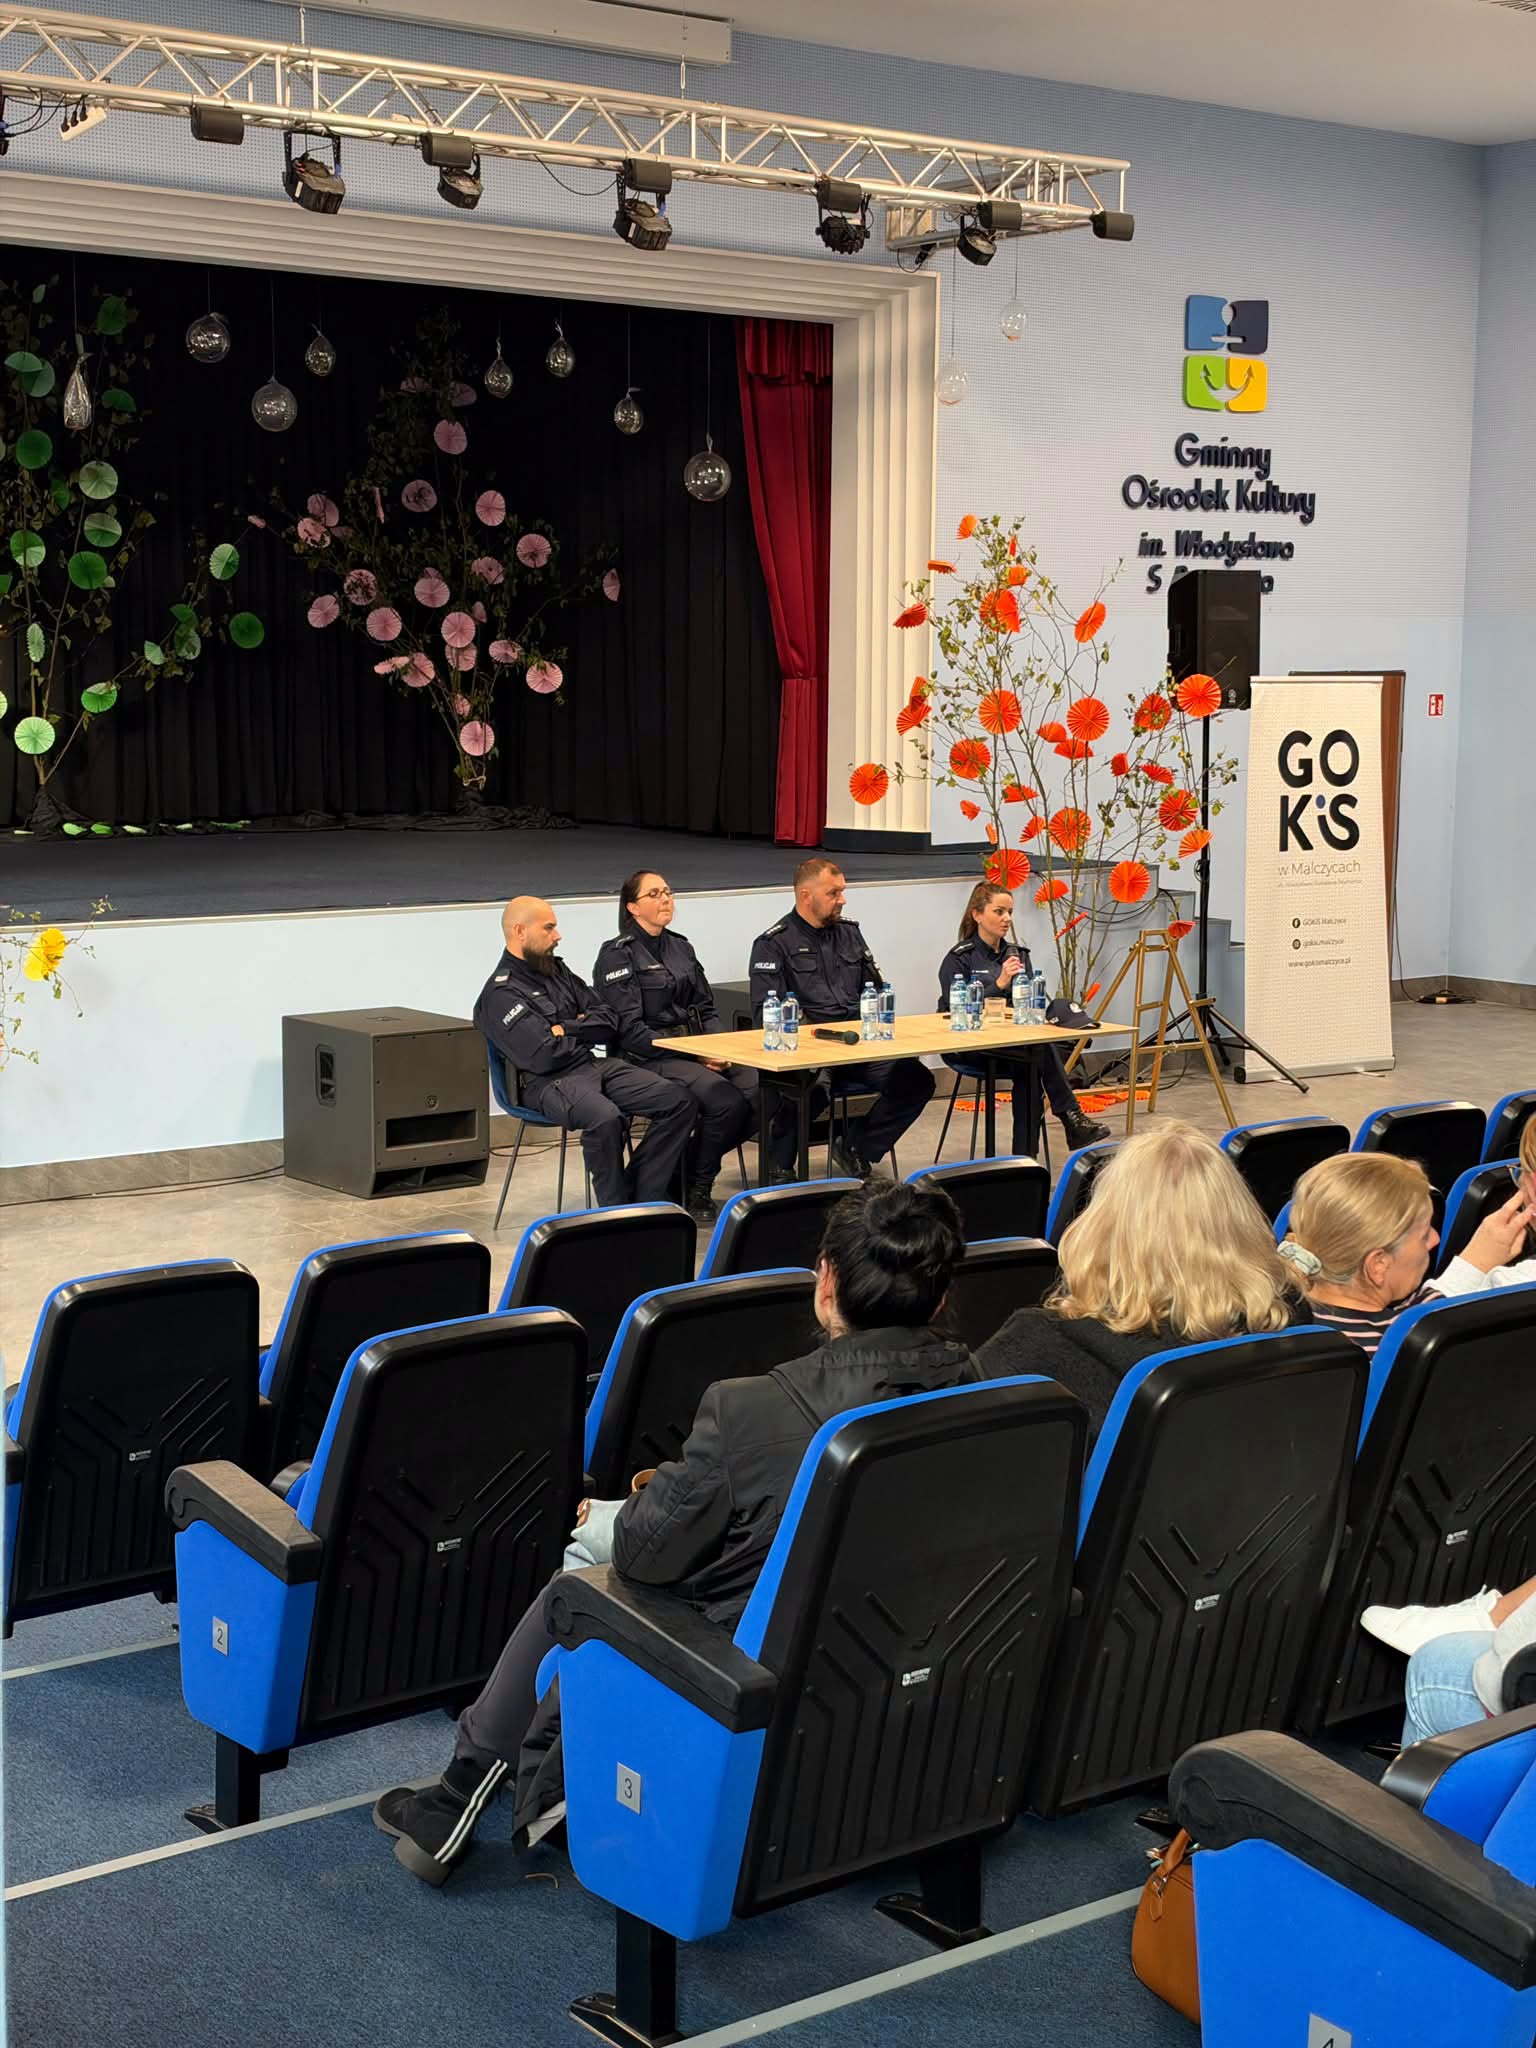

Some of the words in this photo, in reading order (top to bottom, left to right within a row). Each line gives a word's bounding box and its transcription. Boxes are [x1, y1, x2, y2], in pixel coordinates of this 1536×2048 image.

[1175, 432, 1271, 481] Gminny
[1122, 474, 1230, 511] Ośrodek
[1235, 478, 1316, 526] Kultury
[1138, 532, 1167, 558] im.
[1175, 530, 1295, 568] Władysława
[1278, 729, 1360, 788] GO
[1278, 865, 1289, 876] w
[1291, 860, 1361, 877] Malczycach
[605, 967, 630, 982] POLICJA
[753, 962, 777, 970] POLICJA
[502, 1003, 525, 1026] POLICJA
[216, 1627, 224, 1646] 2
[624, 1777, 633, 1800] 3
